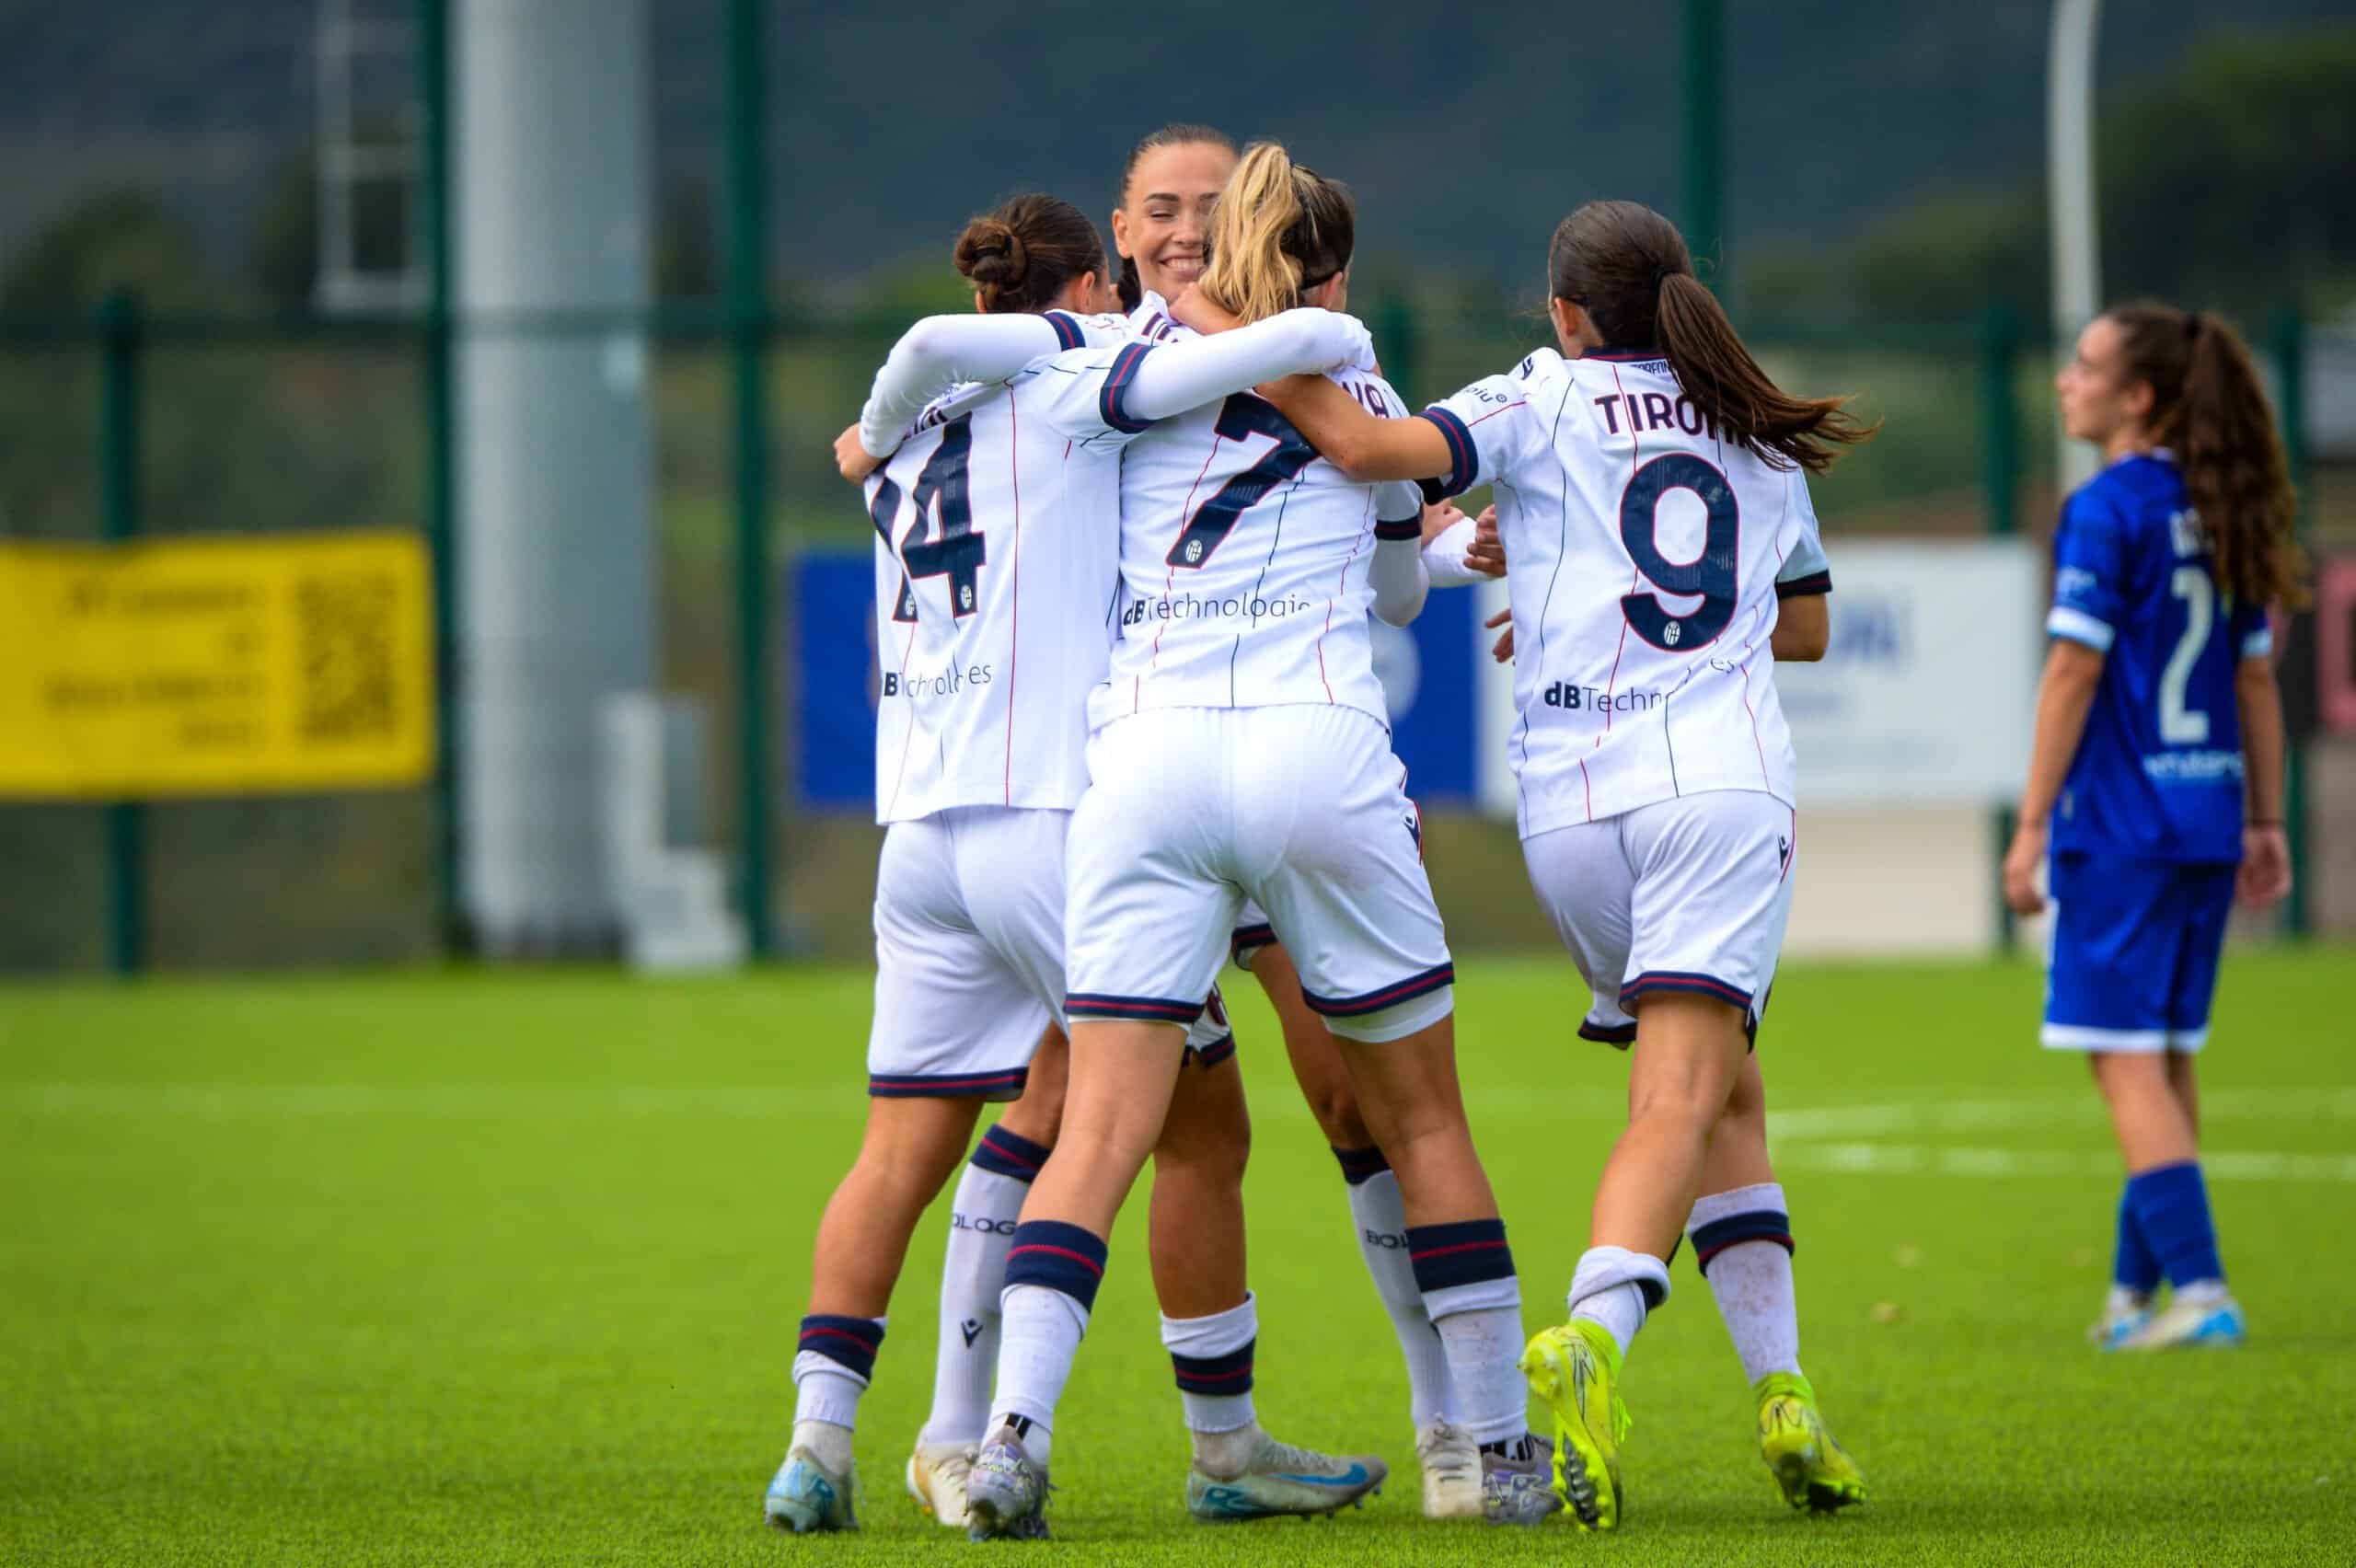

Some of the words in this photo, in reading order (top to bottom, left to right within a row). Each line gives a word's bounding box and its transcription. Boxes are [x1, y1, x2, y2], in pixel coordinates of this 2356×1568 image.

[1166, 392, 1322, 569] 7
[1594, 392, 1747, 448] TIRO
[1620, 451, 1739, 651] 9
[2159, 565, 2213, 744] 2
